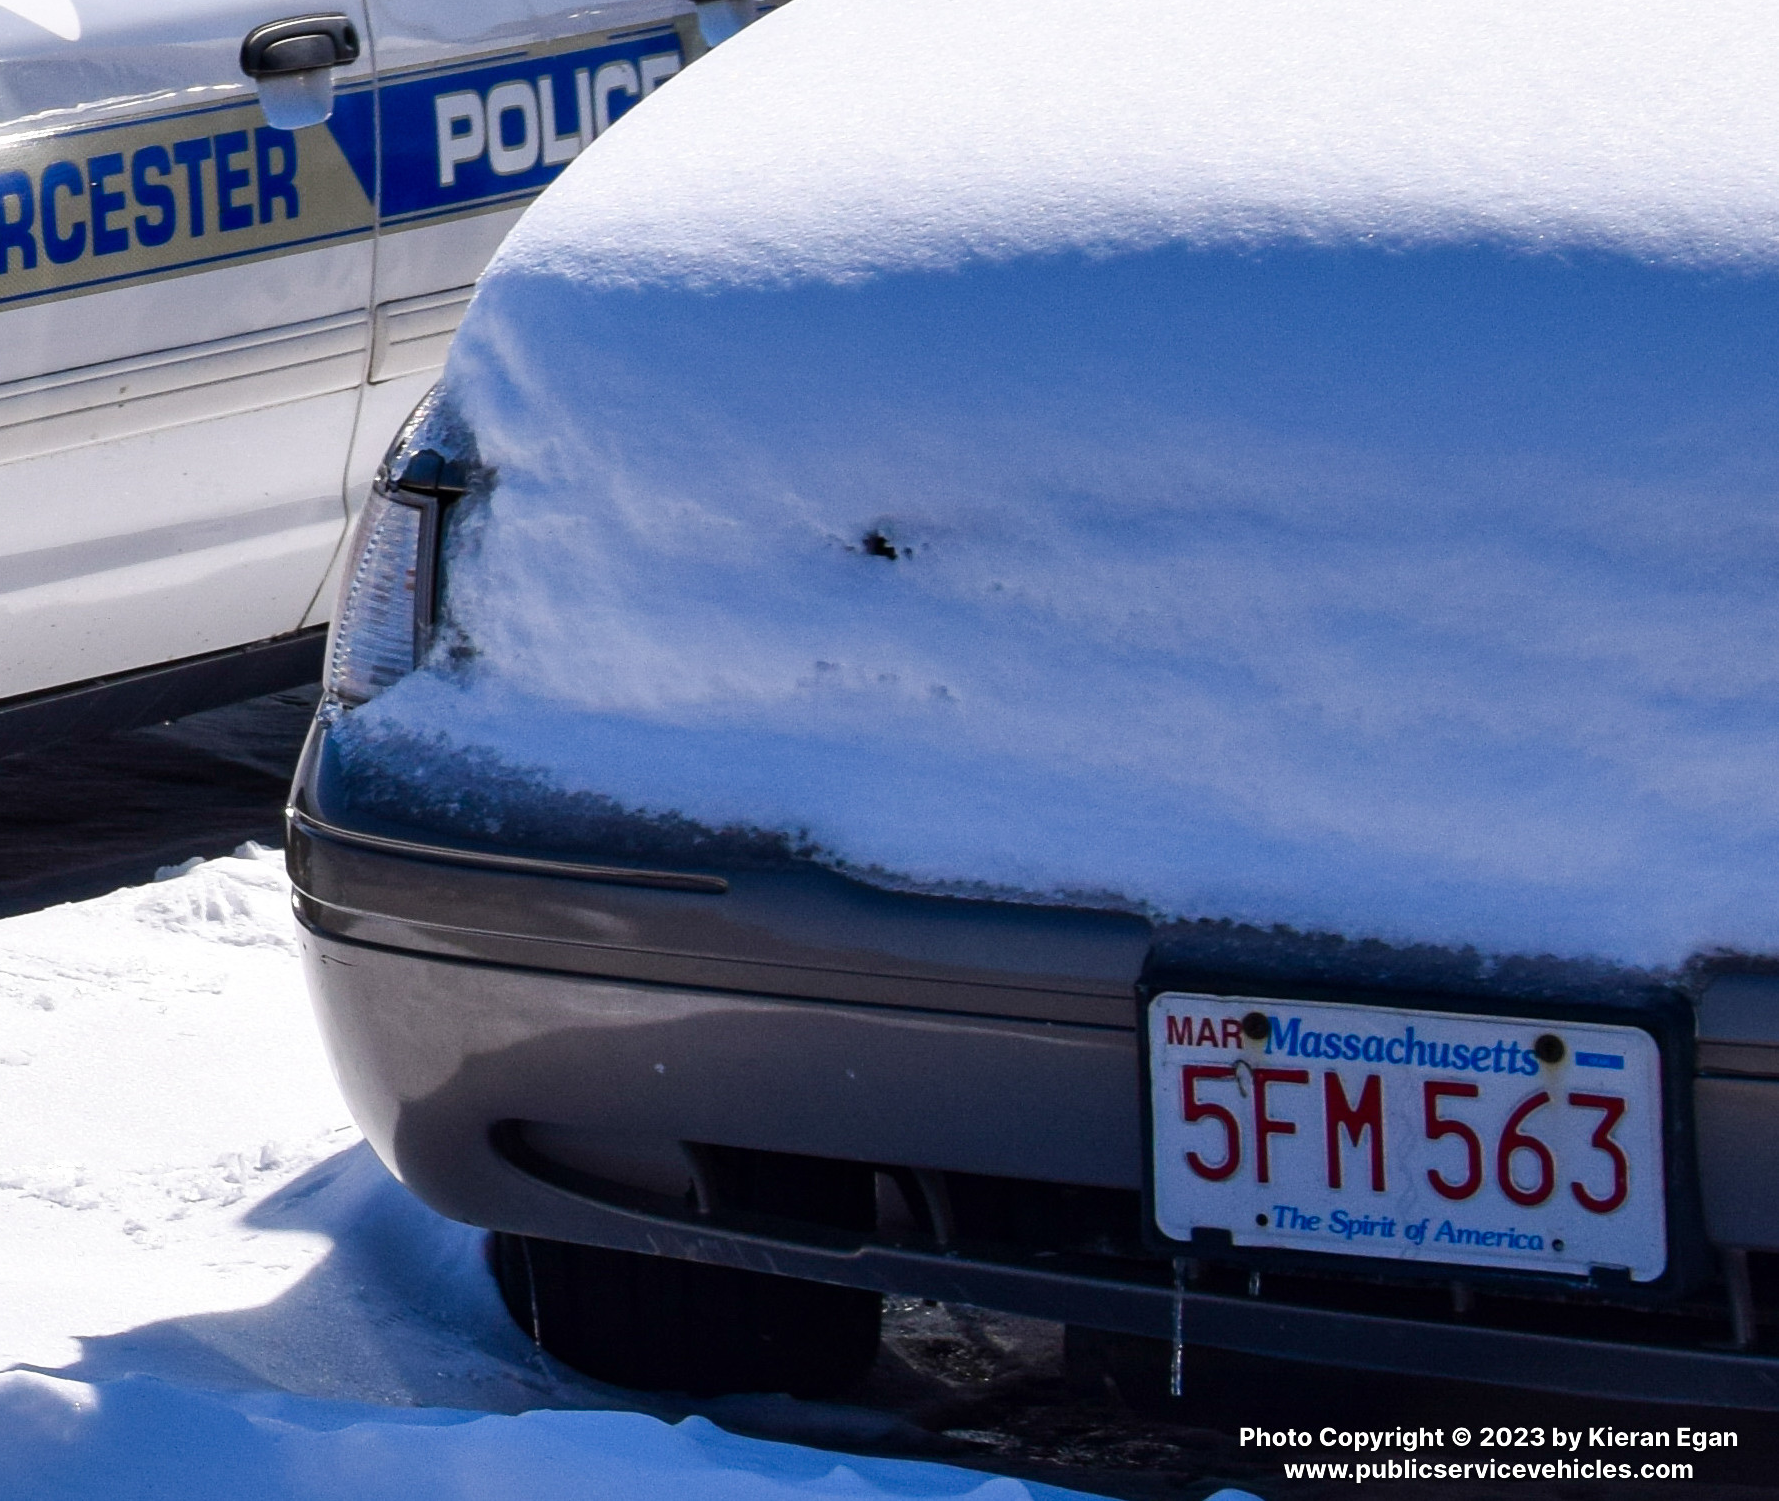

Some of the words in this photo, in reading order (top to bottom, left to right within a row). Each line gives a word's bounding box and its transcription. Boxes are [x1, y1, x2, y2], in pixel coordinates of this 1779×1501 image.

[1167, 1015, 1243, 1050] MAR
[1264, 1015, 1540, 1076] Massachusetts
[1181, 1064, 1386, 1193] 5FM
[1423, 1079, 1629, 1215] 563
[1273, 1204, 1320, 1231] The
[1328, 1209, 1396, 1239] Spirit
[1404, 1218, 1430, 1245] of
[1434, 1220, 1545, 1252] America
